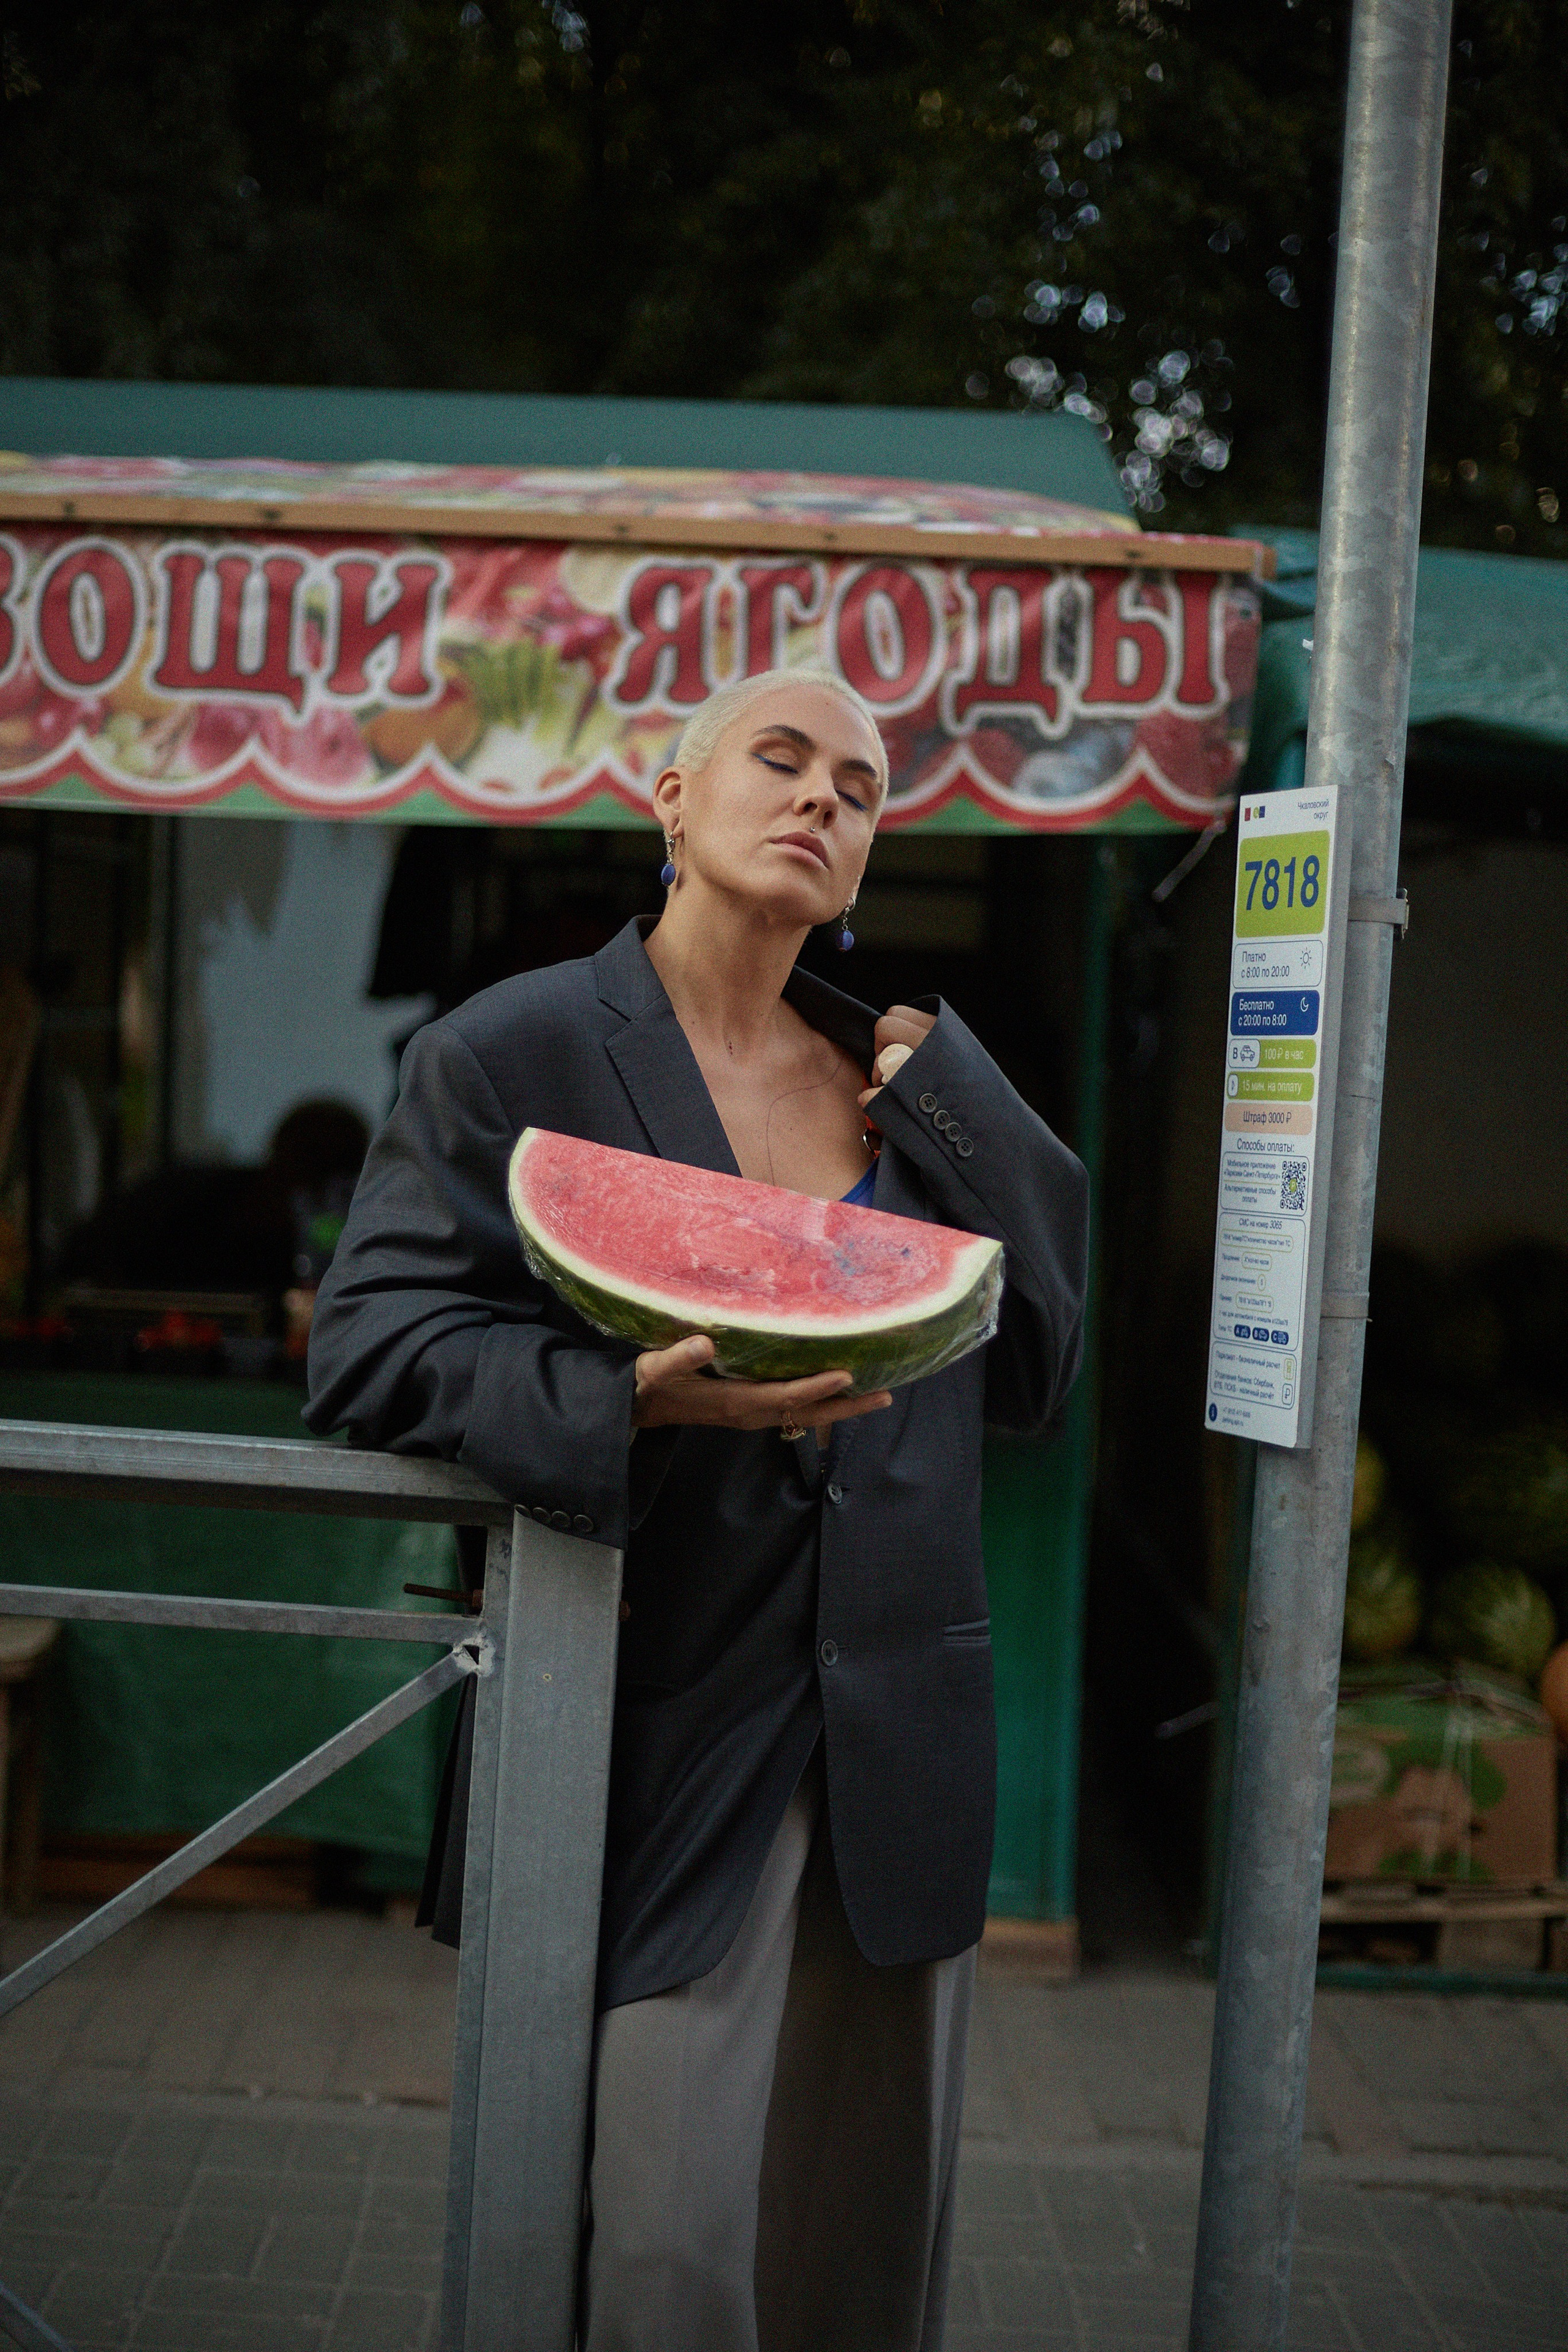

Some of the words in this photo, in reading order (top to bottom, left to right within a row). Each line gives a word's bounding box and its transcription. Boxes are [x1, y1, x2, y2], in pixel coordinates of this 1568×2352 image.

[0, 537, 446, 719] ОЩИ
[611, 559, 1223, 728] ЯГОДЫ
[1297, 799, 1329, 810] Чкаловский
[1313, 811, 1329, 820] округ
[1245, 854, 1321, 911] 7818
[1242, 951, 1267, 963] Платно
[1246, 967, 1261, 978] 8:00
[1261, 970, 1270, 978] по
[1270, 965, 1290, 978] 20:00
[1239, 998, 1275, 1011] Бесплатно
[1238, 1017, 1243, 1026] с
[1243, 1014, 1262, 1026] 20:00
[1262, 1017, 1271, 1026] по
[1272, 1014, 1287, 1026] 8:00
[1285, 1051, 1289, 1060] в
[1290, 1050, 1303, 1060] час
[1242, 1080, 1250, 1090] 15
[1251, 1082, 1265, 1091] мин.
[1268, 1082, 1276, 1091] на
[1277, 1082, 1302, 1095] оплату
[1243, 1110, 1267, 1125] Штраф
[1268, 1111, 1284, 1124] 3000
[1237, 1138, 1266, 1152] Способы
[1267, 1140, 1295, 1153] оплаты:
[1239, 1218, 1249, 1227] СМС
[1270, 1220, 1283, 1230] 3065
